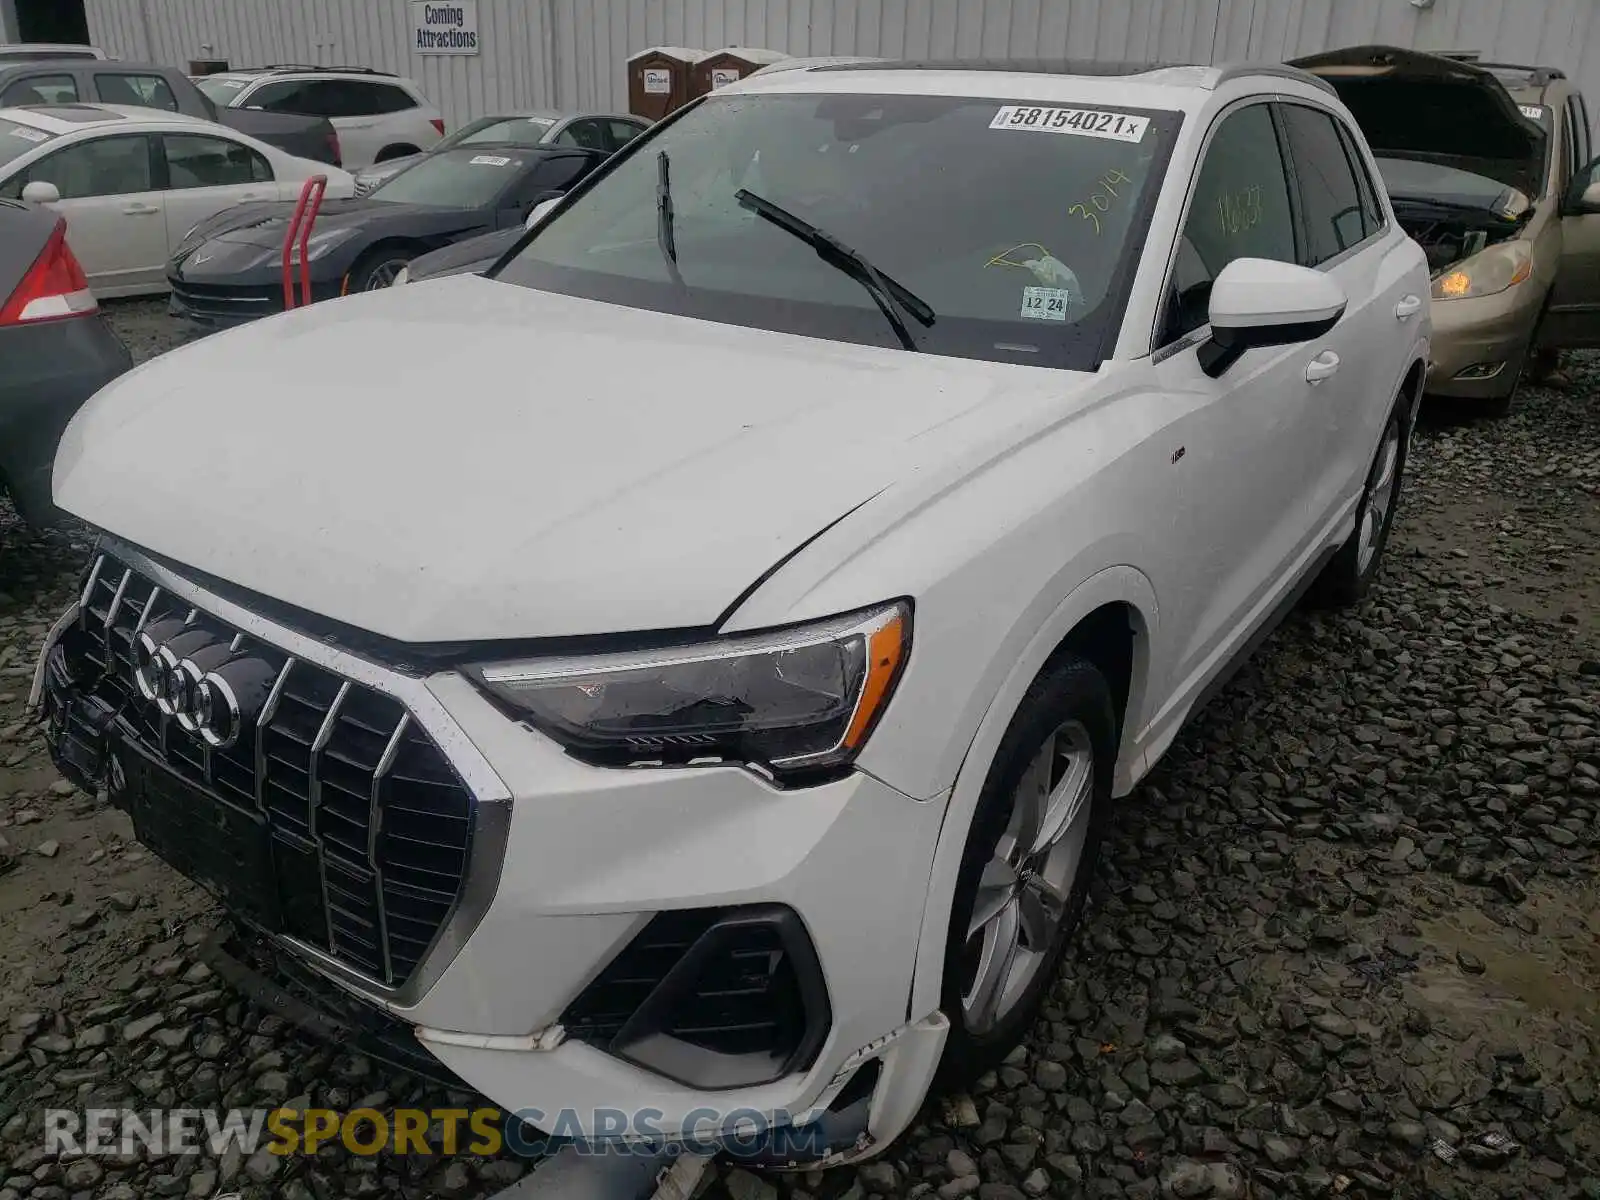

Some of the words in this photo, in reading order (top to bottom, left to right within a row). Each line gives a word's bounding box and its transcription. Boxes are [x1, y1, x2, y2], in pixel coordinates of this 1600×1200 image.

[425, 4, 463, 27] Coming
[417, 28, 476, 48] Attractions
[1010, 107, 1125, 134] 58154021
[1068, 167, 1132, 235] 3014
[1027, 297, 1042, 309] 12
[1047, 298, 1063, 311] 24
